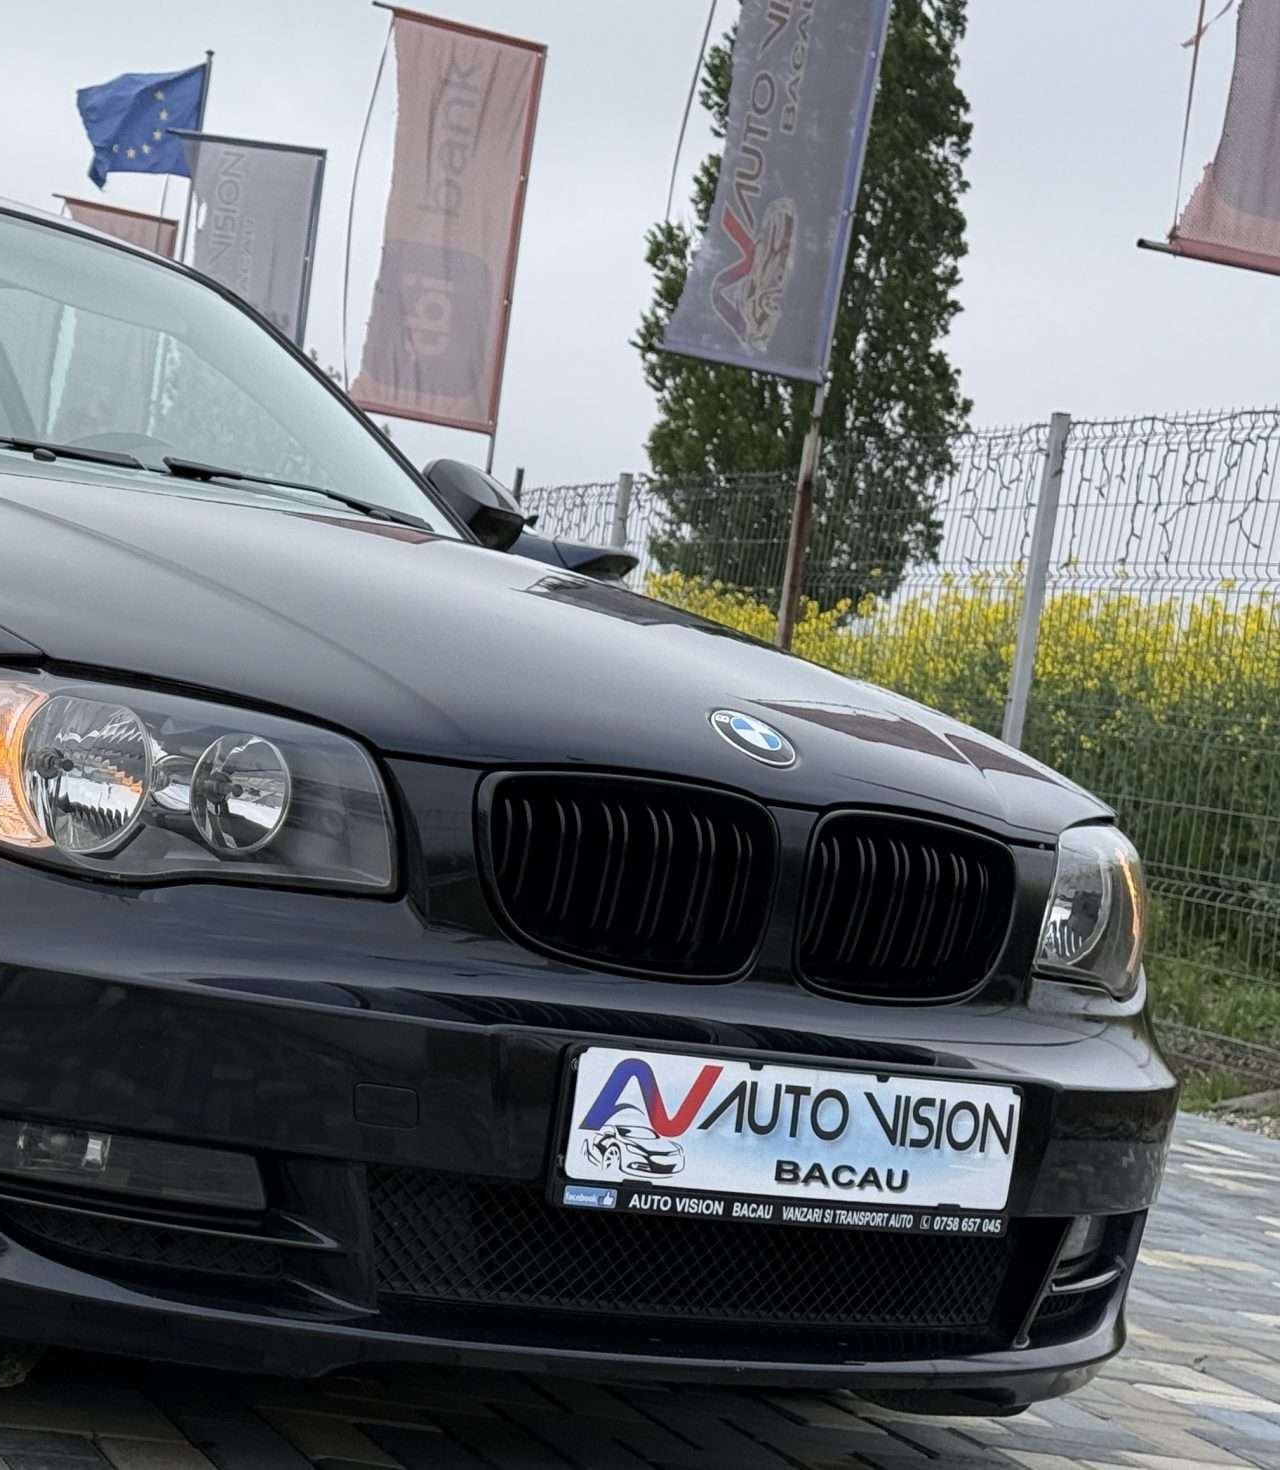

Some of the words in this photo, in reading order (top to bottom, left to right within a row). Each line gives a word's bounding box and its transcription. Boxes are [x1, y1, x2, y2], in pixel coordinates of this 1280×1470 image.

[416, 61, 481, 219] bank
[734, 72, 774, 229] AUTO
[208, 151, 245, 266] VISION
[403, 273, 453, 360] tbi
[697, 1080, 850, 1140] AUTO
[864, 1091, 1015, 1156] VISION
[629, 1193, 670, 1211] AUTO
[675, 1197, 724, 1215] VISION
[732, 1202, 773, 1219] BACAU
[774, 1159, 909, 1192] BACAU
[782, 1206, 821, 1222] VANZARI
[823, 1209, 833, 1223] SI
[835, 1210, 889, 1227] TRANSPORT
[888, 1214, 913, 1228] AUTO
[933, 1216, 959, 1230] 0758
[961, 1217, 979, 1232] 657
[982, 1218, 1002, 1232] 045
